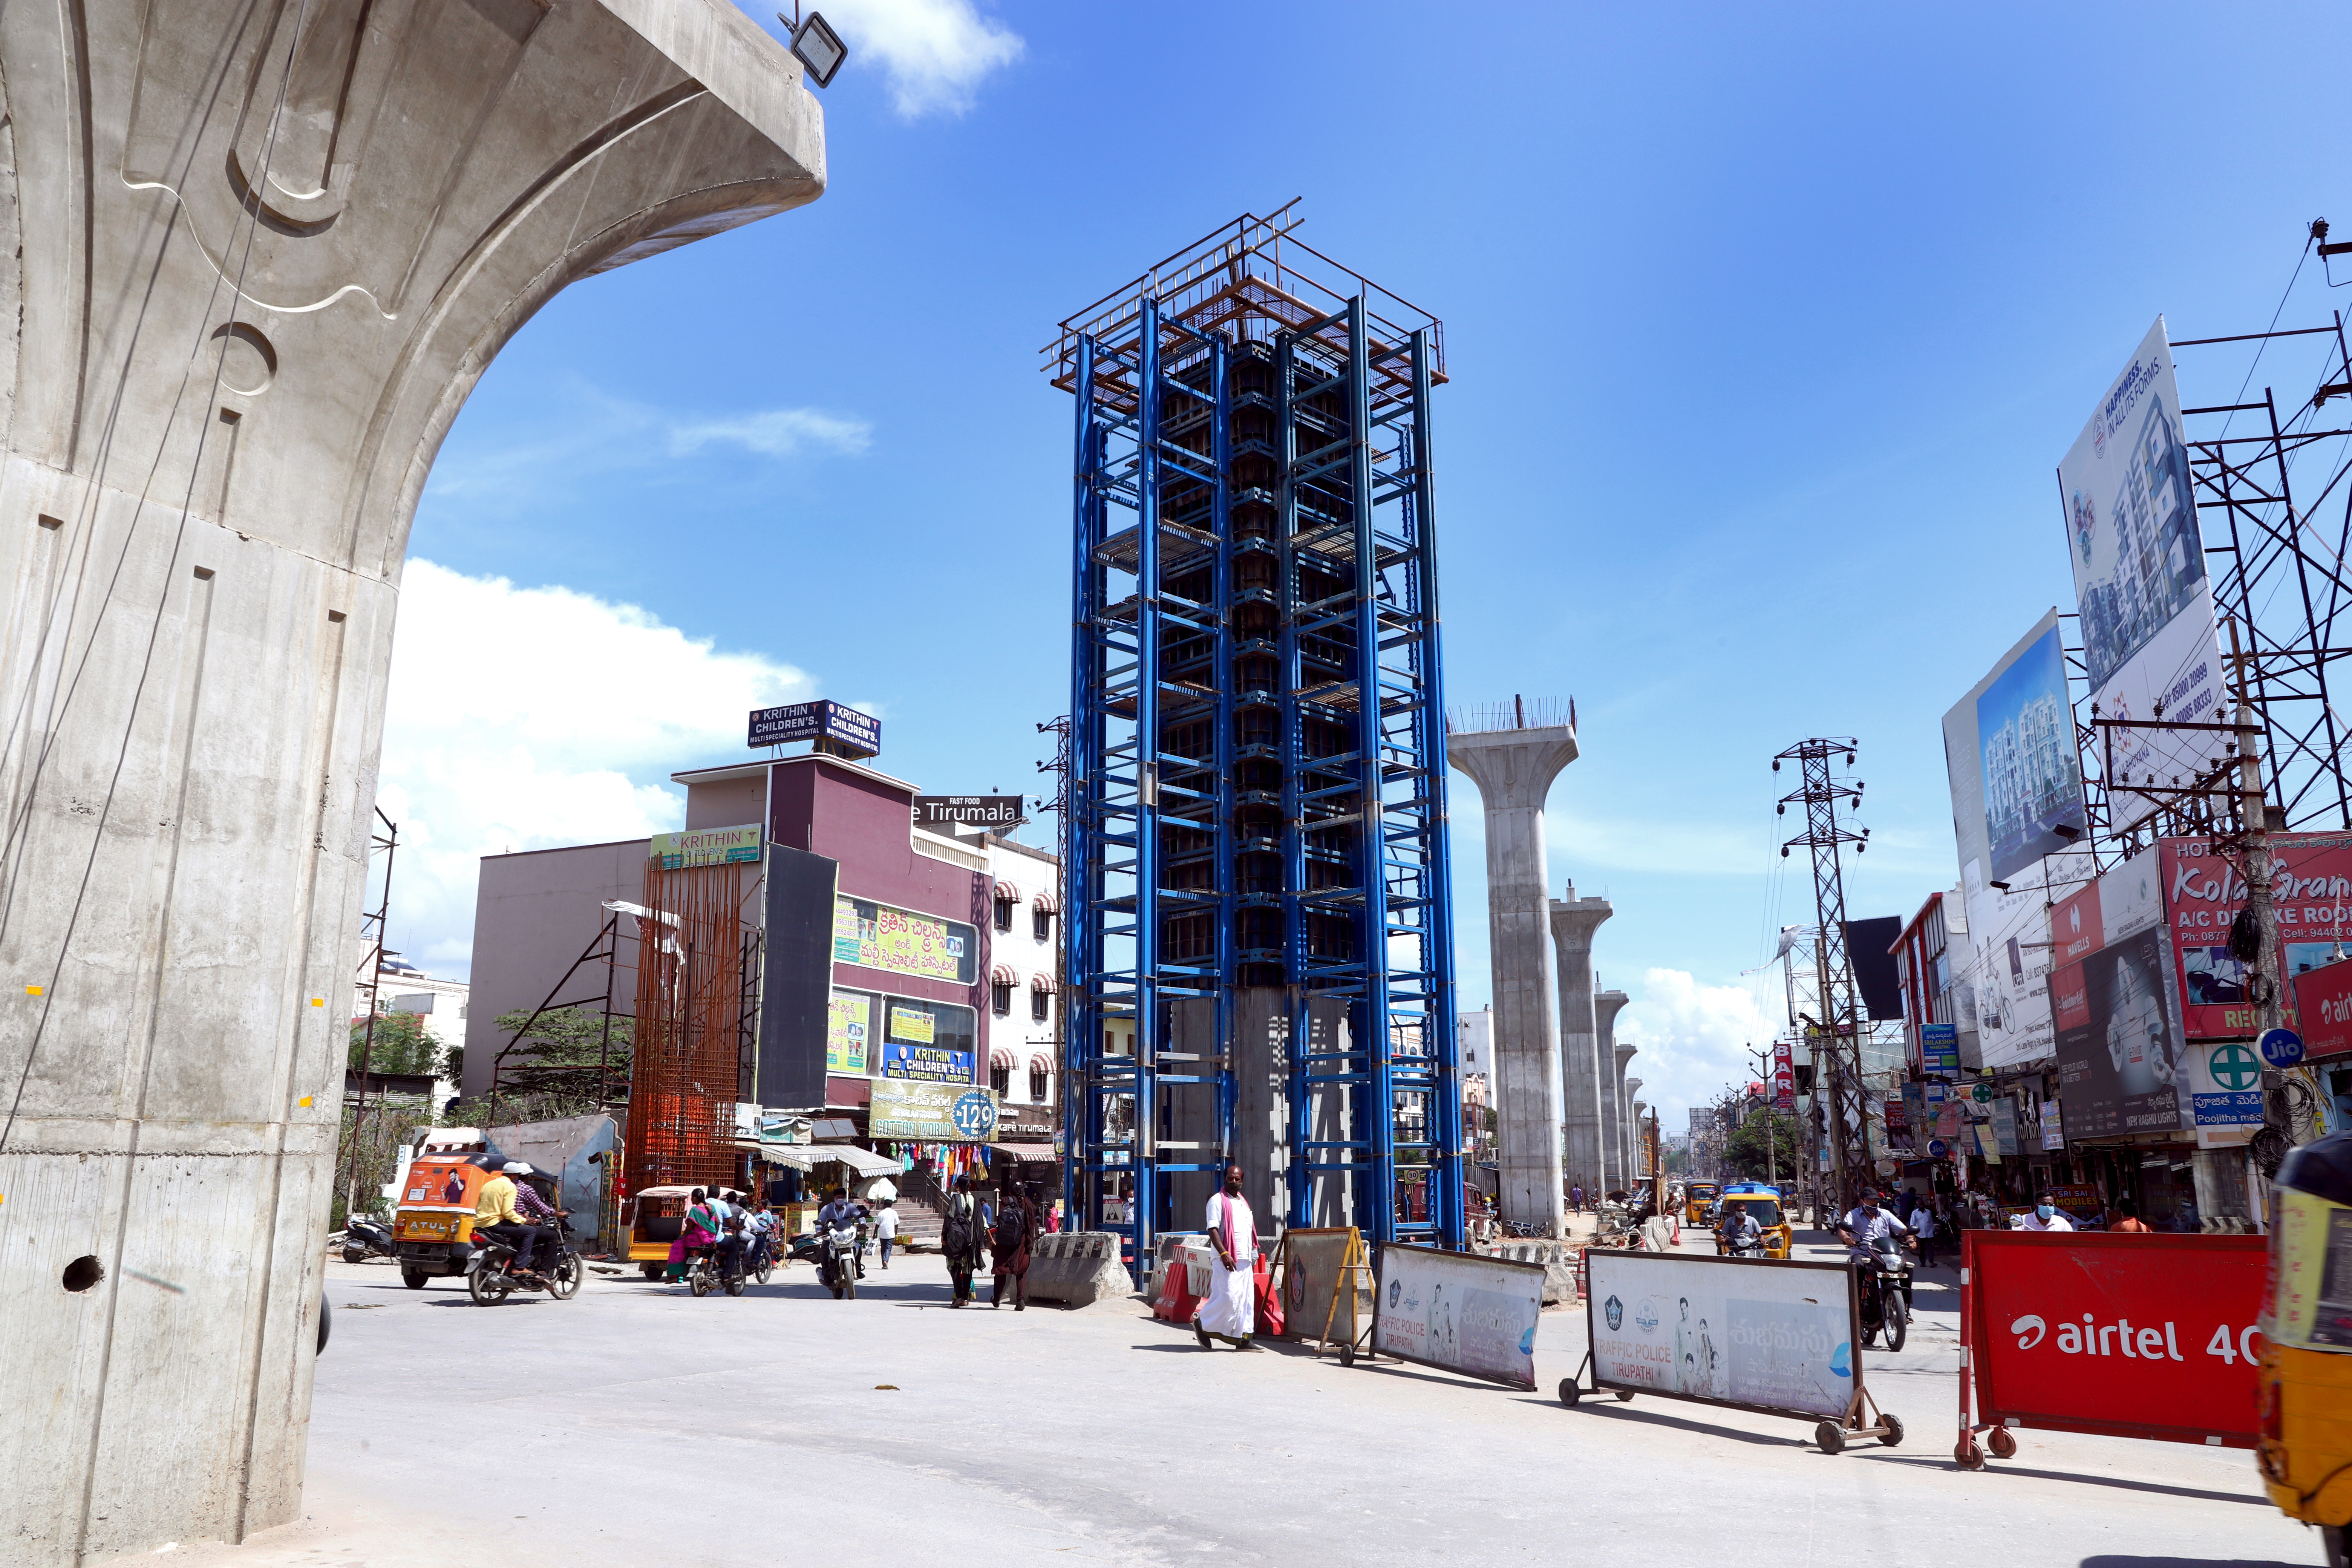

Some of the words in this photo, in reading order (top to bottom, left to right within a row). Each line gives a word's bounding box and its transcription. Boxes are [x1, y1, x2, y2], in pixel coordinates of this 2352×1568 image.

[2105, 360, 2142, 421] HAPPINESS.
[2108, 419, 2115, 439] IN
[2115, 405, 2126, 430] ALL
[2125, 390, 2134, 415] ITS
[2135, 357, 2161, 401] FORMS.
[2172, 677, 2188, 703] 85000
[2189, 662, 2208, 689] 20999
[2194, 688, 2212, 715] 88333
[764, 704, 807, 720] KRITHIN
[837, 706, 870, 728] KRITHIN
[756, 716, 814, 733] CHILDREN'S
[795, 727, 819, 737] HOSPITAL
[831, 717, 875, 741] CHILDREN'S
[861, 740, 879, 752] HOSPITAL
[926, 802, 1015, 820] Tirumala
[681, 831, 741, 849] KRITHIN
[2178, 911, 2211, 928] A/C
[2182, 932, 2199, 942] Ph:
[2283, 928, 2308, 938] Cell:
[2067, 936, 2090, 957] HAVELLS
[915, 1048, 951, 1063] KRITHIN
[2267, 1040, 2300, 1060] Jio
[906, 1060, 955, 1073] CHILDREN'S
[1775, 1045, 1793, 1090] BAR
[888, 1069, 906, 1078] MULTI
[909, 1070, 943, 1081] SPECIALITY
[946, 1074, 972, 1083] HOSPITAL
[961, 1104, 992, 1129] 129
[2126, 1116, 2138, 1127] NEW
[2138, 1113, 2156, 1126] RAGHU
[2158, 1111, 2177, 1124] LIGHTS
[2197, 1113, 2237, 1124] Poojitha
[875, 1118, 916, 1137] COTTON
[919, 1121, 952, 1138] WORLD
[1931, 1145, 1944, 1153] Jio
[2056, 1197, 2097, 1206] MOBILES
[410, 1221, 446, 1230] ATUL
[1377, 1314, 1400, 1331] TRAFFIC
[1402, 1320, 1425, 1337] POLICE
[1608, 1320, 1620, 1329] POLICE
[2057, 1313, 2184, 1361] airtel
[1594, 1338, 1632, 1358] TRAFFIC
[1635, 1344, 1671, 1363] POLICE
[1612, 1362, 1654, 1381] TIRUPATHI
